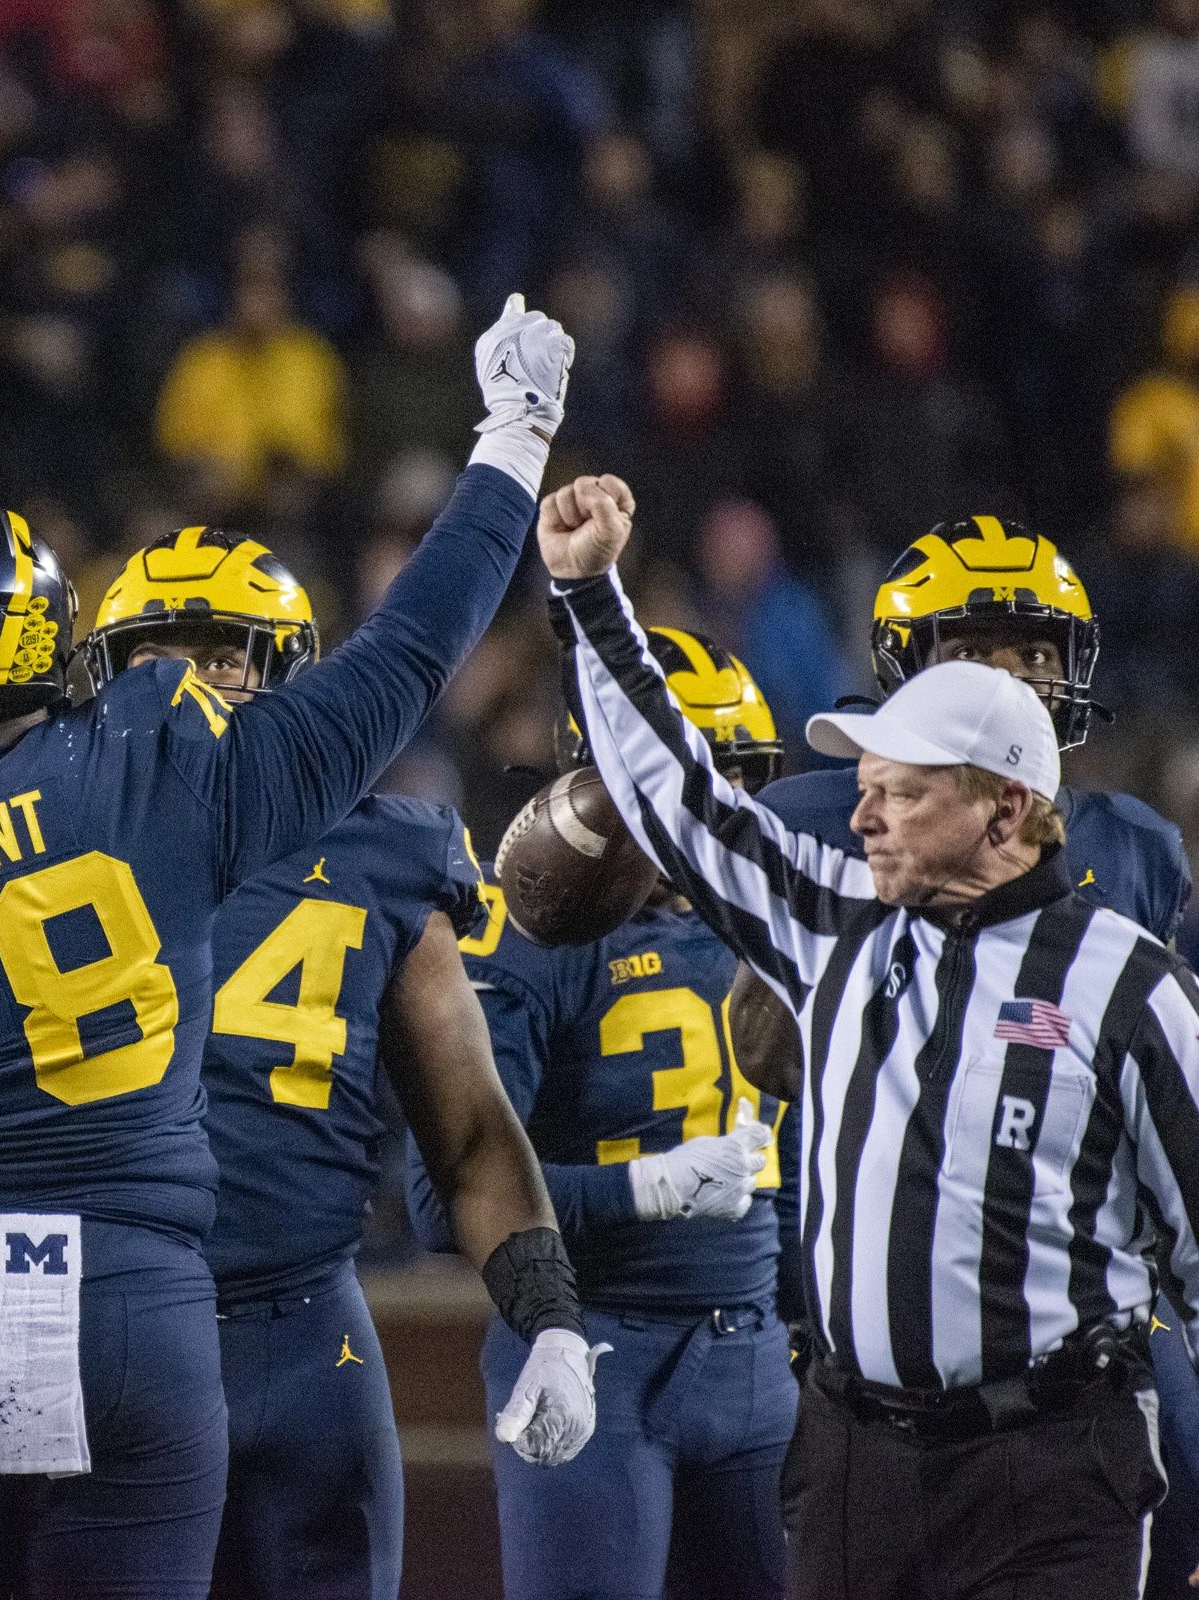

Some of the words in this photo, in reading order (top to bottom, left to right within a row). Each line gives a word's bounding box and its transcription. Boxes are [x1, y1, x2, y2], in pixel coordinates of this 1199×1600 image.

[1006, 744, 1023, 767] S
[884, 962, 906, 999] S
[996, 1095, 1037, 1151] R
[5, 1232, 69, 1276] M
